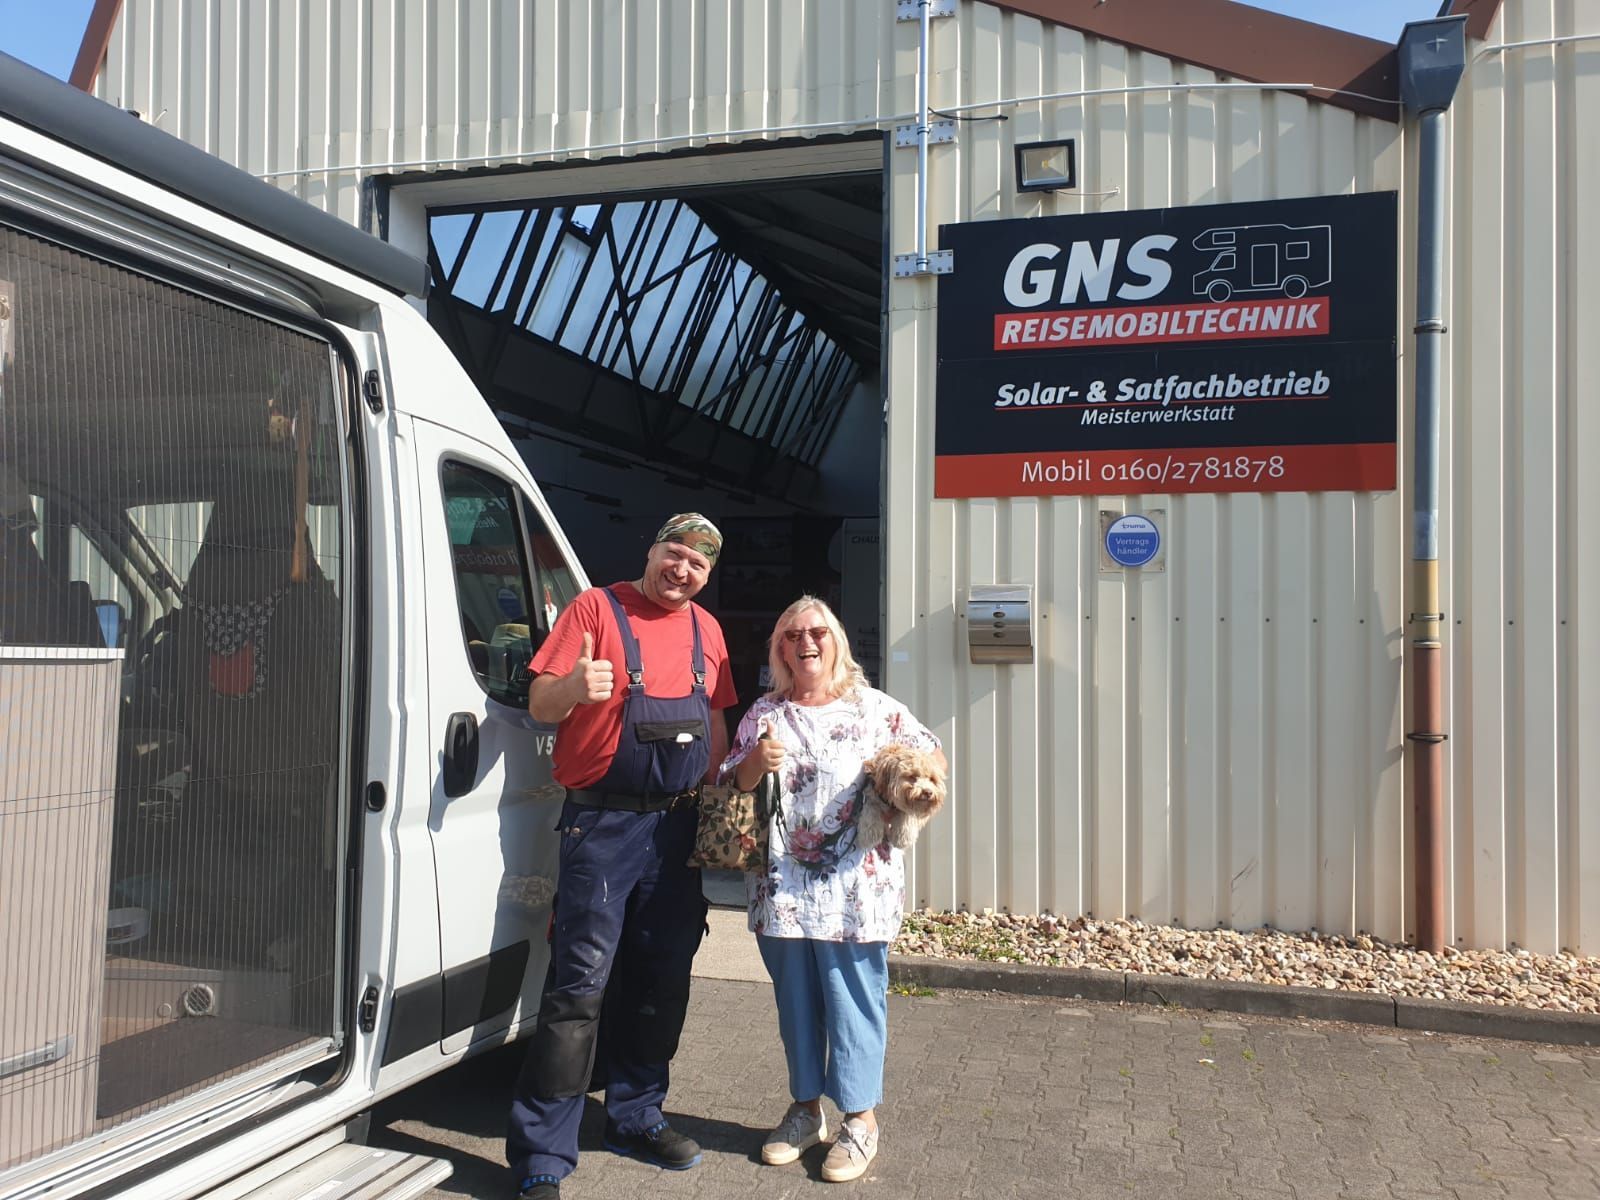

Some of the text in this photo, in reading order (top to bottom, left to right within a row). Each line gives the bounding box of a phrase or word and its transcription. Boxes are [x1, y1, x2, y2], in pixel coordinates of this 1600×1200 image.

[1003, 234, 1178, 308] GNS
[1001, 303, 1321, 344] REISEMOBILTECHNIK
[994, 370, 1330, 407] Solar- & Satfachbetrieb
[1080, 405, 1236, 426] Meisterwerkstatt
[1021, 455, 1285, 484] Mobil 0160/2781878
[1115, 537, 1149, 546] Vertrags
